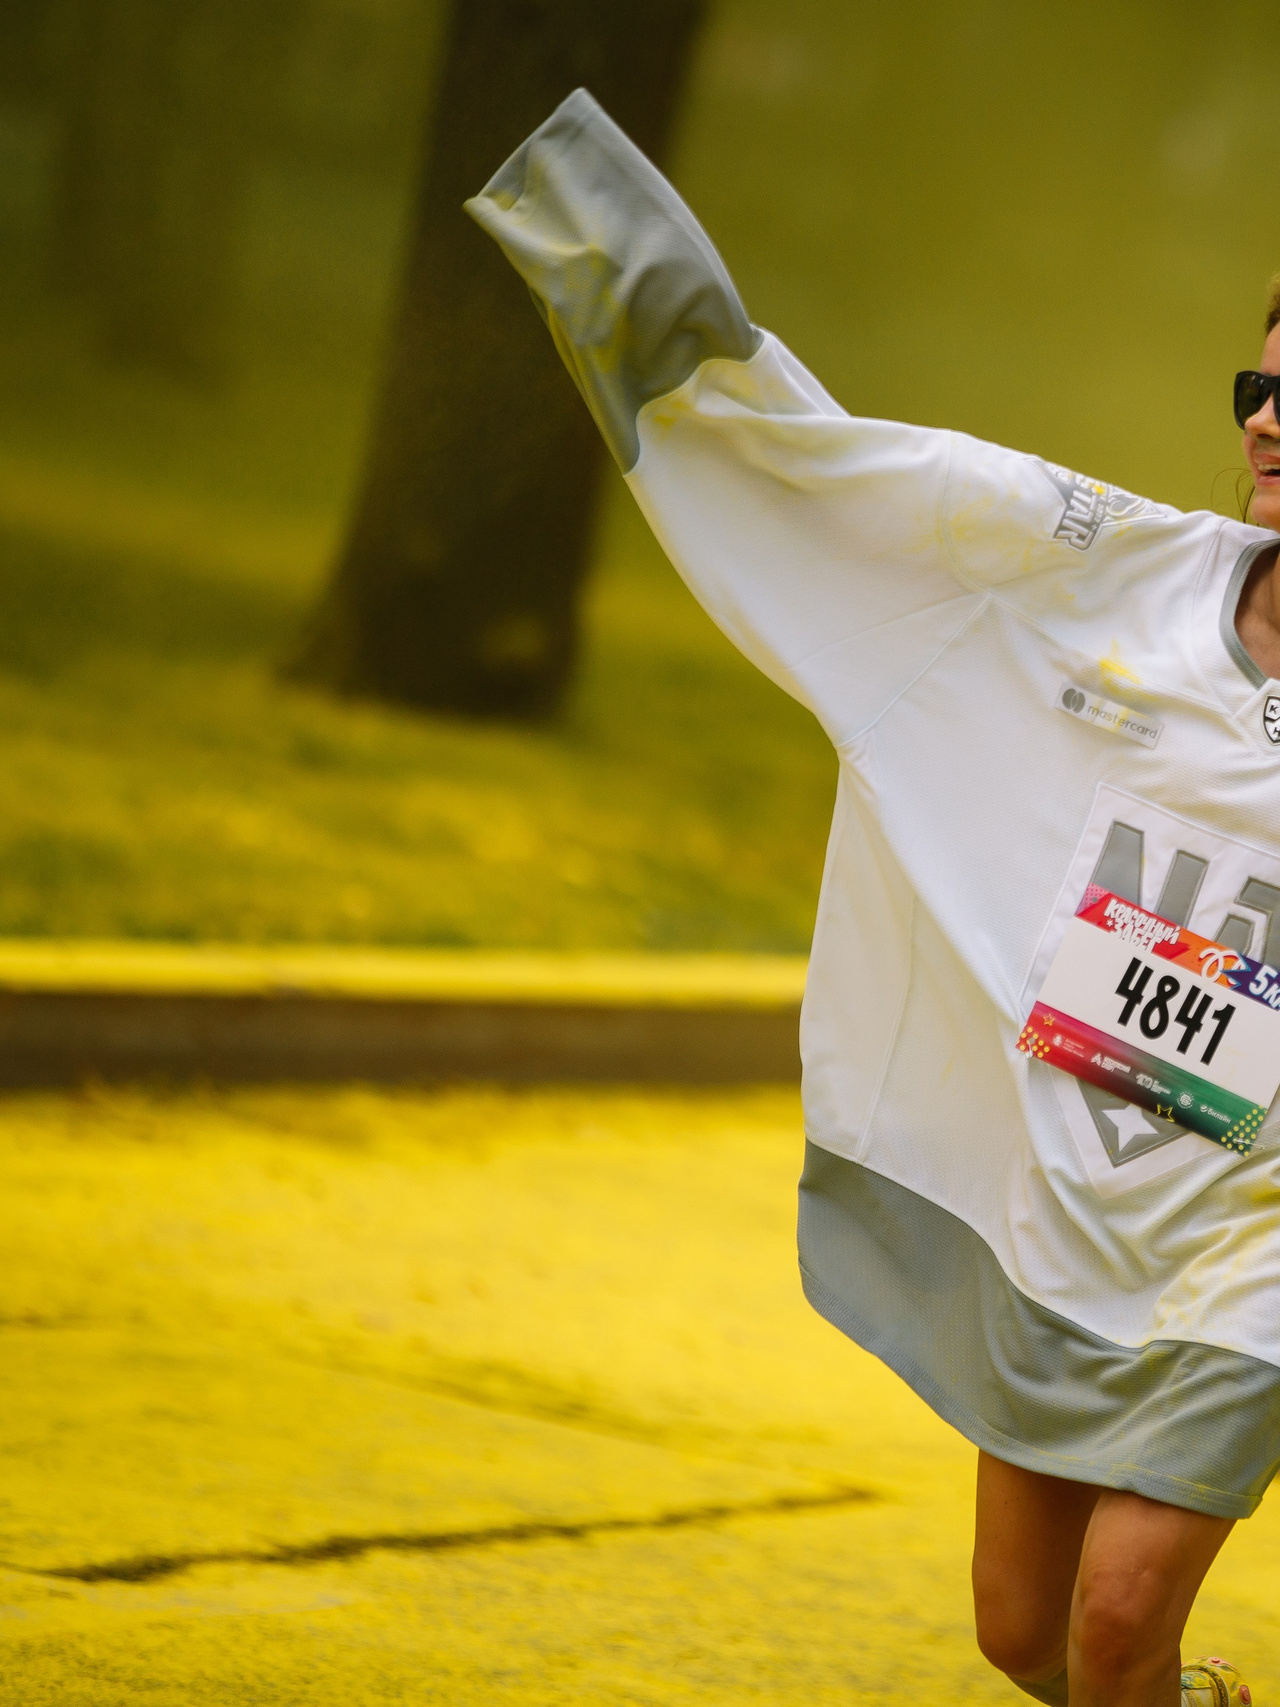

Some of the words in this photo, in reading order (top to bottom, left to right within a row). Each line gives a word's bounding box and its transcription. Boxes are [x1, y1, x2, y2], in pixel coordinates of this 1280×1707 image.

[1087, 705, 1157, 739] mastercard
[1103, 898, 1181, 945] КРАСОЧНЫЙ
[1114, 918, 1164, 954] ЗАБЕГ
[1114, 956, 1237, 1067] 4841
